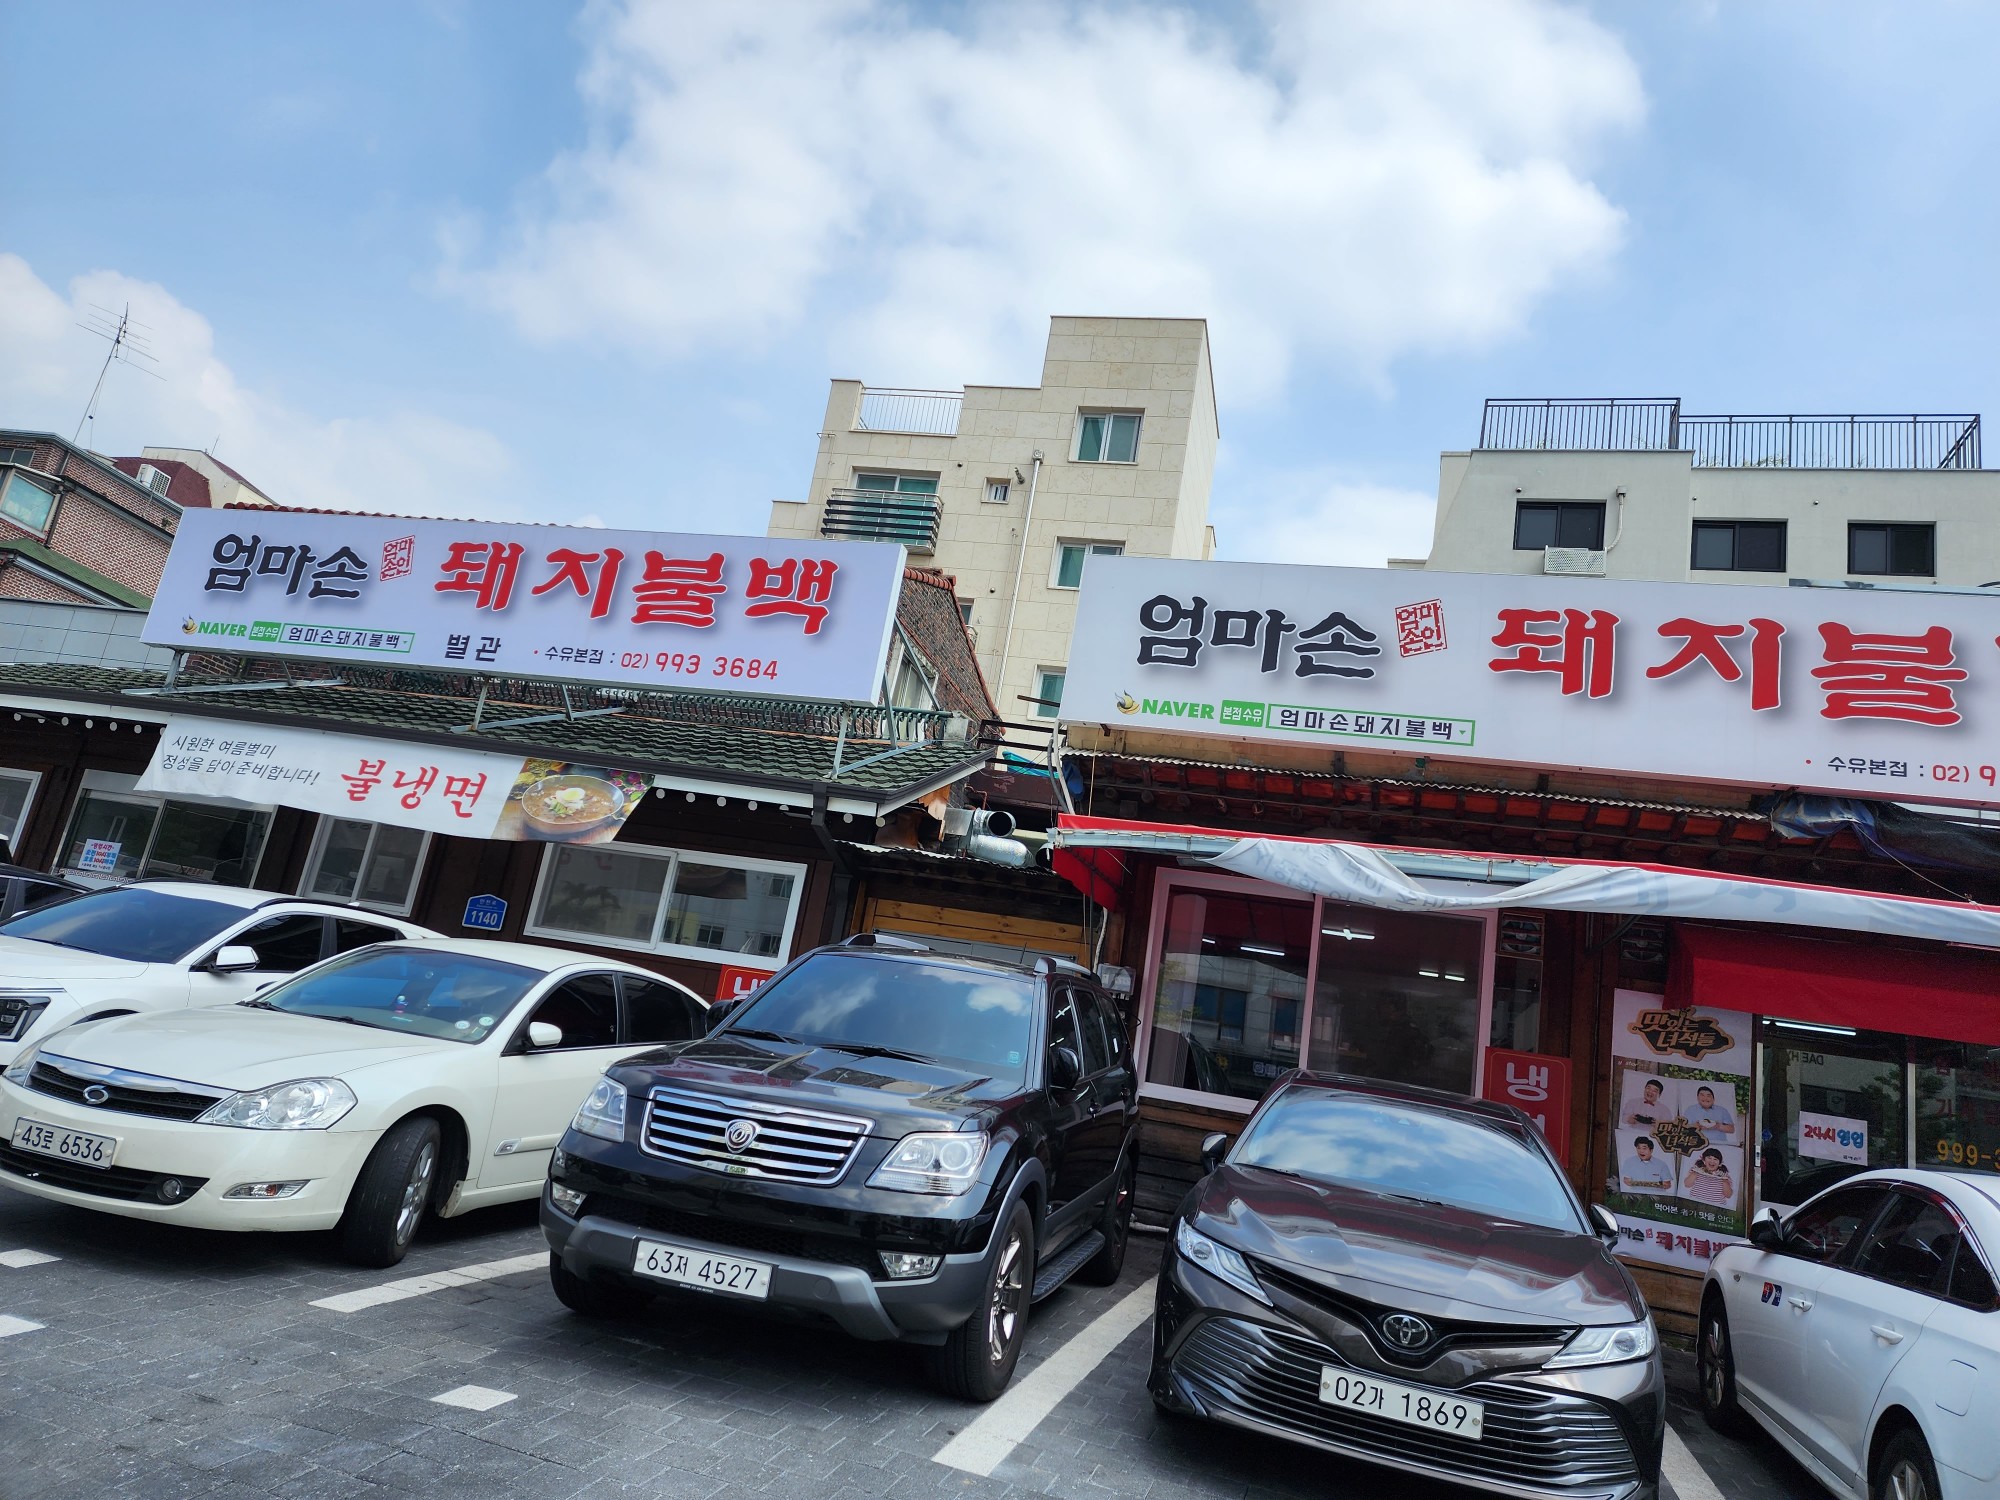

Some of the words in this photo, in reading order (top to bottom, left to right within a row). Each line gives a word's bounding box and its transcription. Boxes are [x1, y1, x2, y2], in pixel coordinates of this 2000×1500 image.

[204, 533, 368, 600] 엄마손
[434, 541, 839, 636] 돼지불백
[198, 621, 248, 637] NAVER
[445, 633, 502, 662] 별관
[544, 646, 603, 664] 수유본점
[620, 652, 649, 669] 02)
[655, 652, 700, 674] 993
[712, 656, 778, 680] 3684
[1136, 594, 1382, 680] 엄마손
[1488, 608, 2000, 727] 돼지불
[1141, 698, 1214, 719] NAVER
[172, 735, 215, 752] 시원한
[219, 740, 277, 759] 여름별미
[163, 754, 204, 772] 정성을
[206, 759, 236, 774] 담아
[236, 761, 321, 786] 준비합니다!
[1827, 756, 1908, 778] 수유본점
[1932, 765, 1970, 783] 02)
[340, 758, 488, 820] 불냉면
[471, 910, 498, 926] 1140
[22, 1125, 54, 1148] 43로
[59, 1133, 104, 1162] 6536
[1618, 1224, 1645, 1241] 마손
[646, 1248, 688, 1275] 63저
[697, 1260, 758, 1290] 4527
[1335, 1376, 1385, 1410] 02가
[1401, 1393, 1468, 1430] 1869
